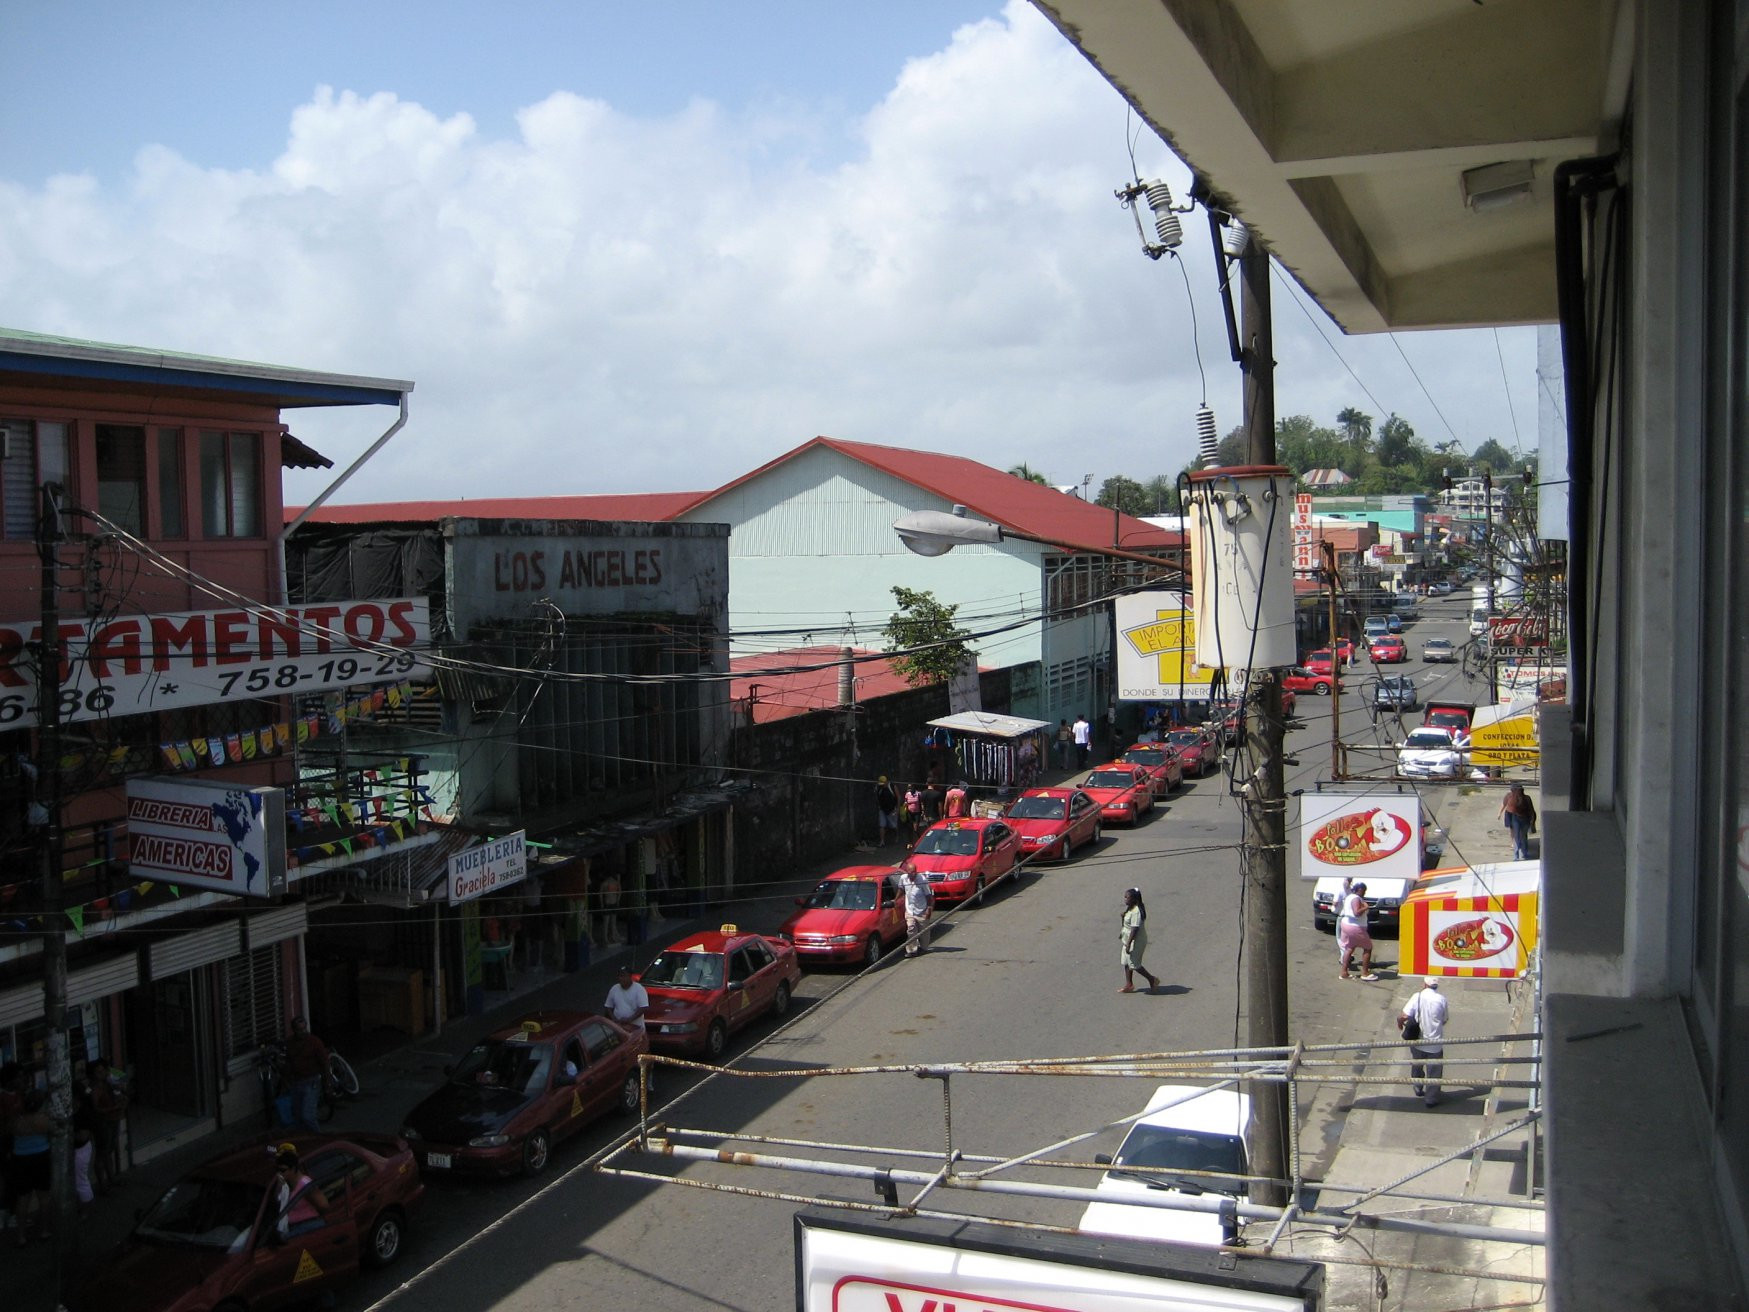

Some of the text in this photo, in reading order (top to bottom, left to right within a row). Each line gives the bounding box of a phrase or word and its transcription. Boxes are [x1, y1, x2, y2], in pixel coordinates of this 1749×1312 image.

[494, 550, 662, 592] LOS ANGELES
[1147, 639, 1167, 650] EL
[1491, 647, 1533, 655] SUPER
[218, 651, 416, 697] 758-19-29
[1122, 688, 1157, 696] DONDE
[1162, 688, 1174, 696] SU
[129, 799, 212, 830] LIBRERIA
[131, 835, 230, 877] AMERICAS
[456, 837, 522, 874] MUEBLERIA
[506, 858, 517, 868] TEL
[455, 867, 496, 897] Graciela
